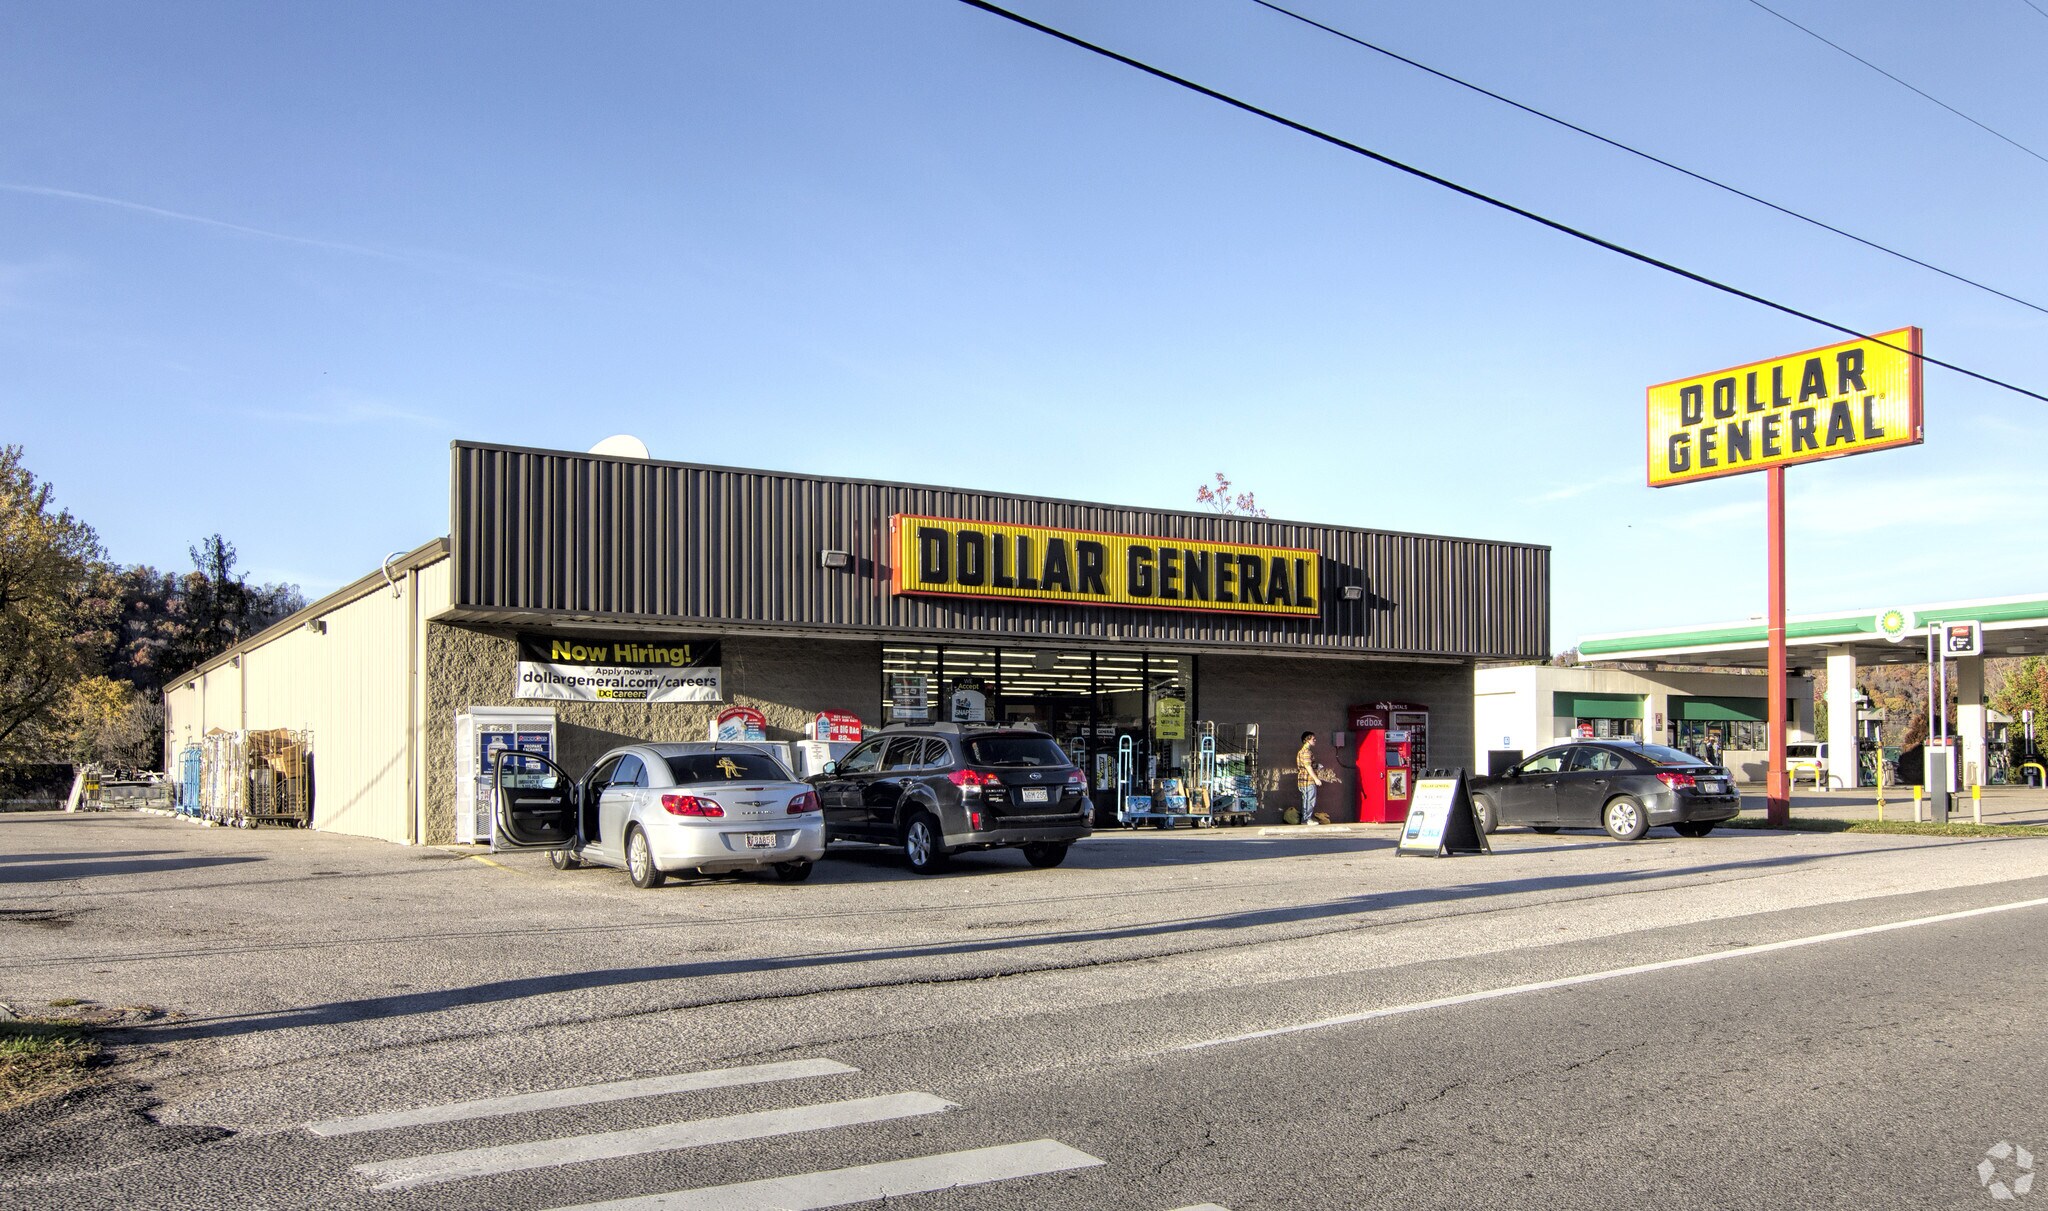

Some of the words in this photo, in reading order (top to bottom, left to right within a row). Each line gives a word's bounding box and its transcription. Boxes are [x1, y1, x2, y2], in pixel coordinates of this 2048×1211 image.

[1680, 348, 1867, 427] DOLLAR
[1669, 395, 1885, 473] GENERAL
[917, 527, 1109, 595] DOLLAR
[1127, 545, 1317, 608] GENERAL
[551, 640, 607, 662] Now
[614, 643, 692, 667] Hiring!
[523, 671, 717, 689] dollargeneral.com/careers
[595, 667, 623, 676] Apply
[598, 690, 612, 698] DG
[612, 690, 648, 698] careers
[830, 725, 839, 734] THE
[840, 725, 848, 734] BIG
[849, 726, 859, 735] BAG
[1356, 718, 1383, 727] redbox
